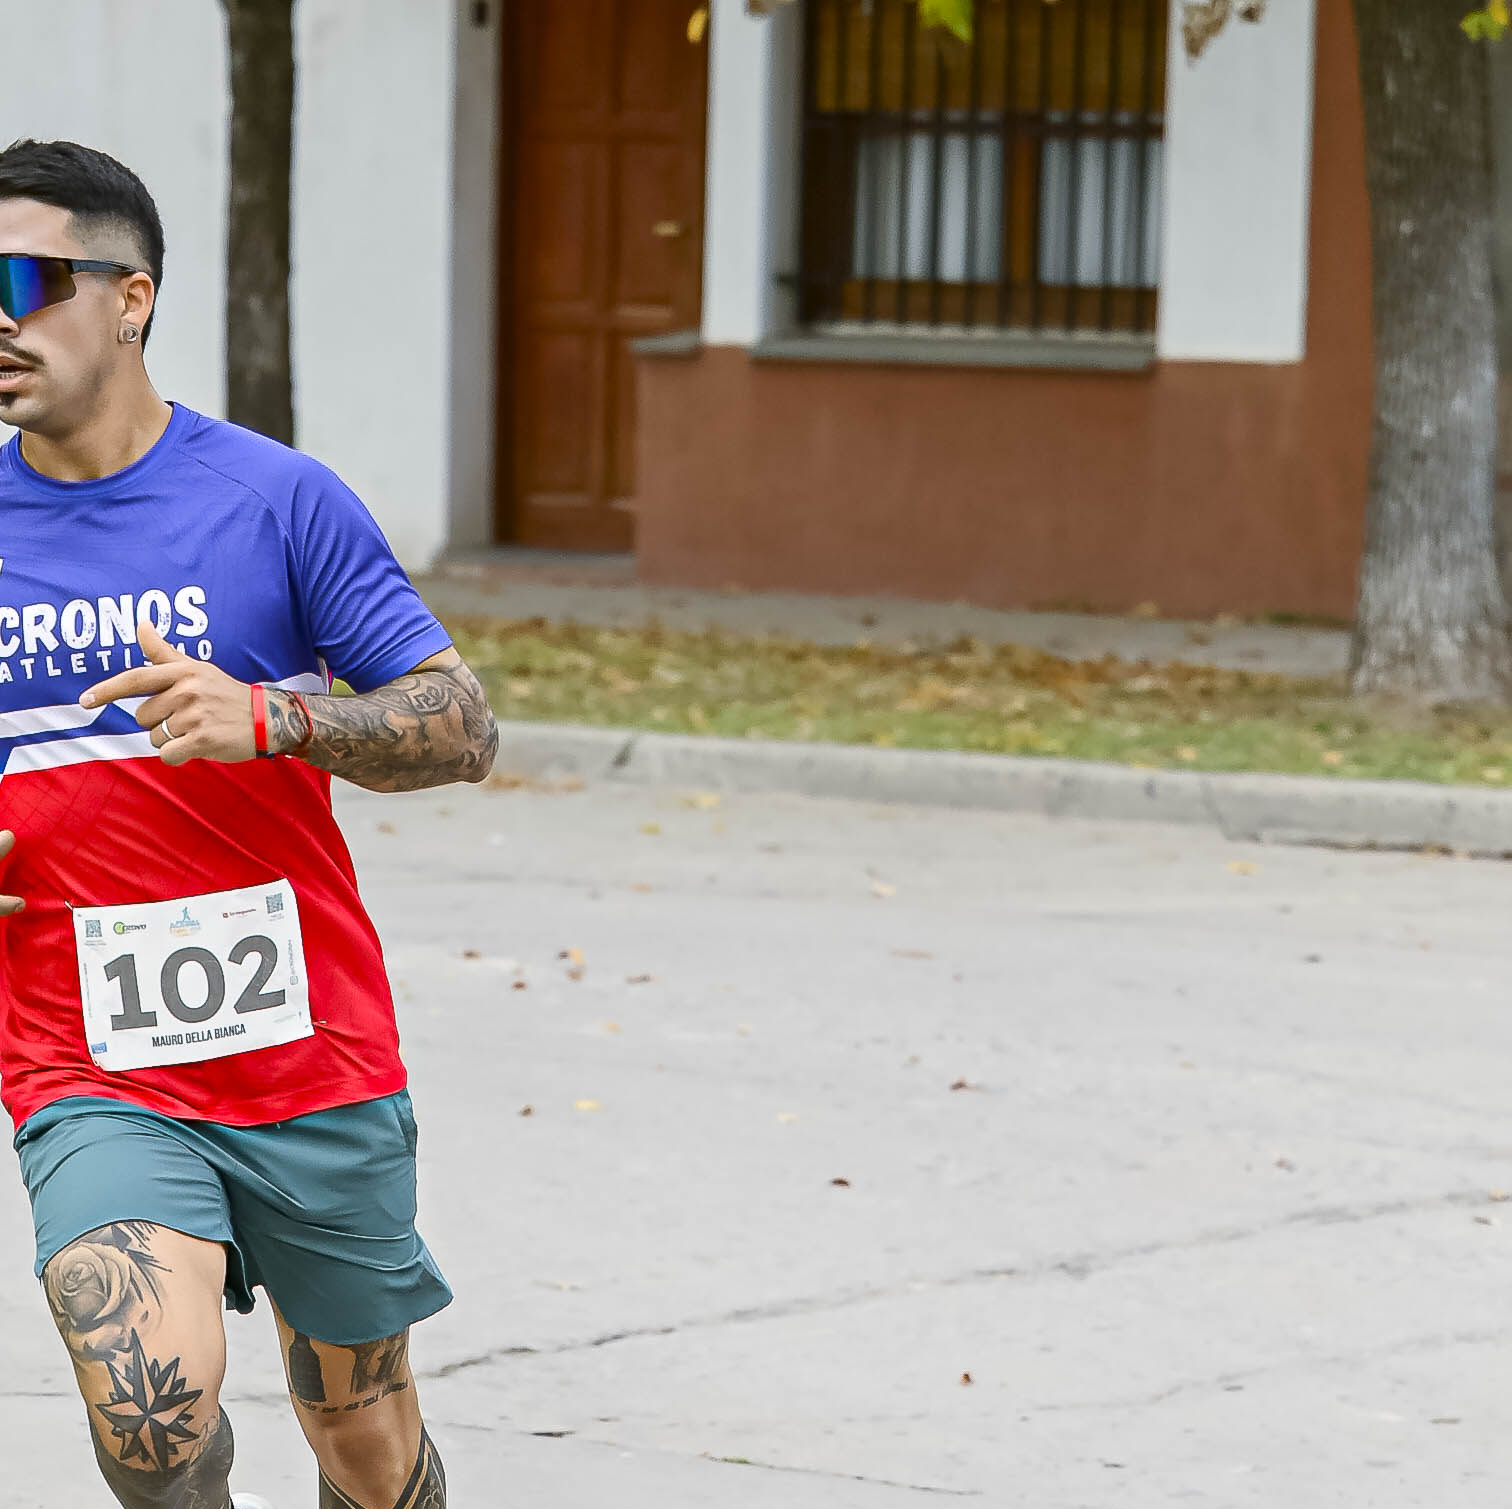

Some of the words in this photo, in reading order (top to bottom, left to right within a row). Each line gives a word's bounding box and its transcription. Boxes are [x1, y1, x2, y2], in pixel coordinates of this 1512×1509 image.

[104, 935, 286, 1031] 102
[152, 1034, 183, 1047] MAURO
[185, 1030, 212, 1043] DELLA
[214, 1024, 246, 1039] BIANCA
